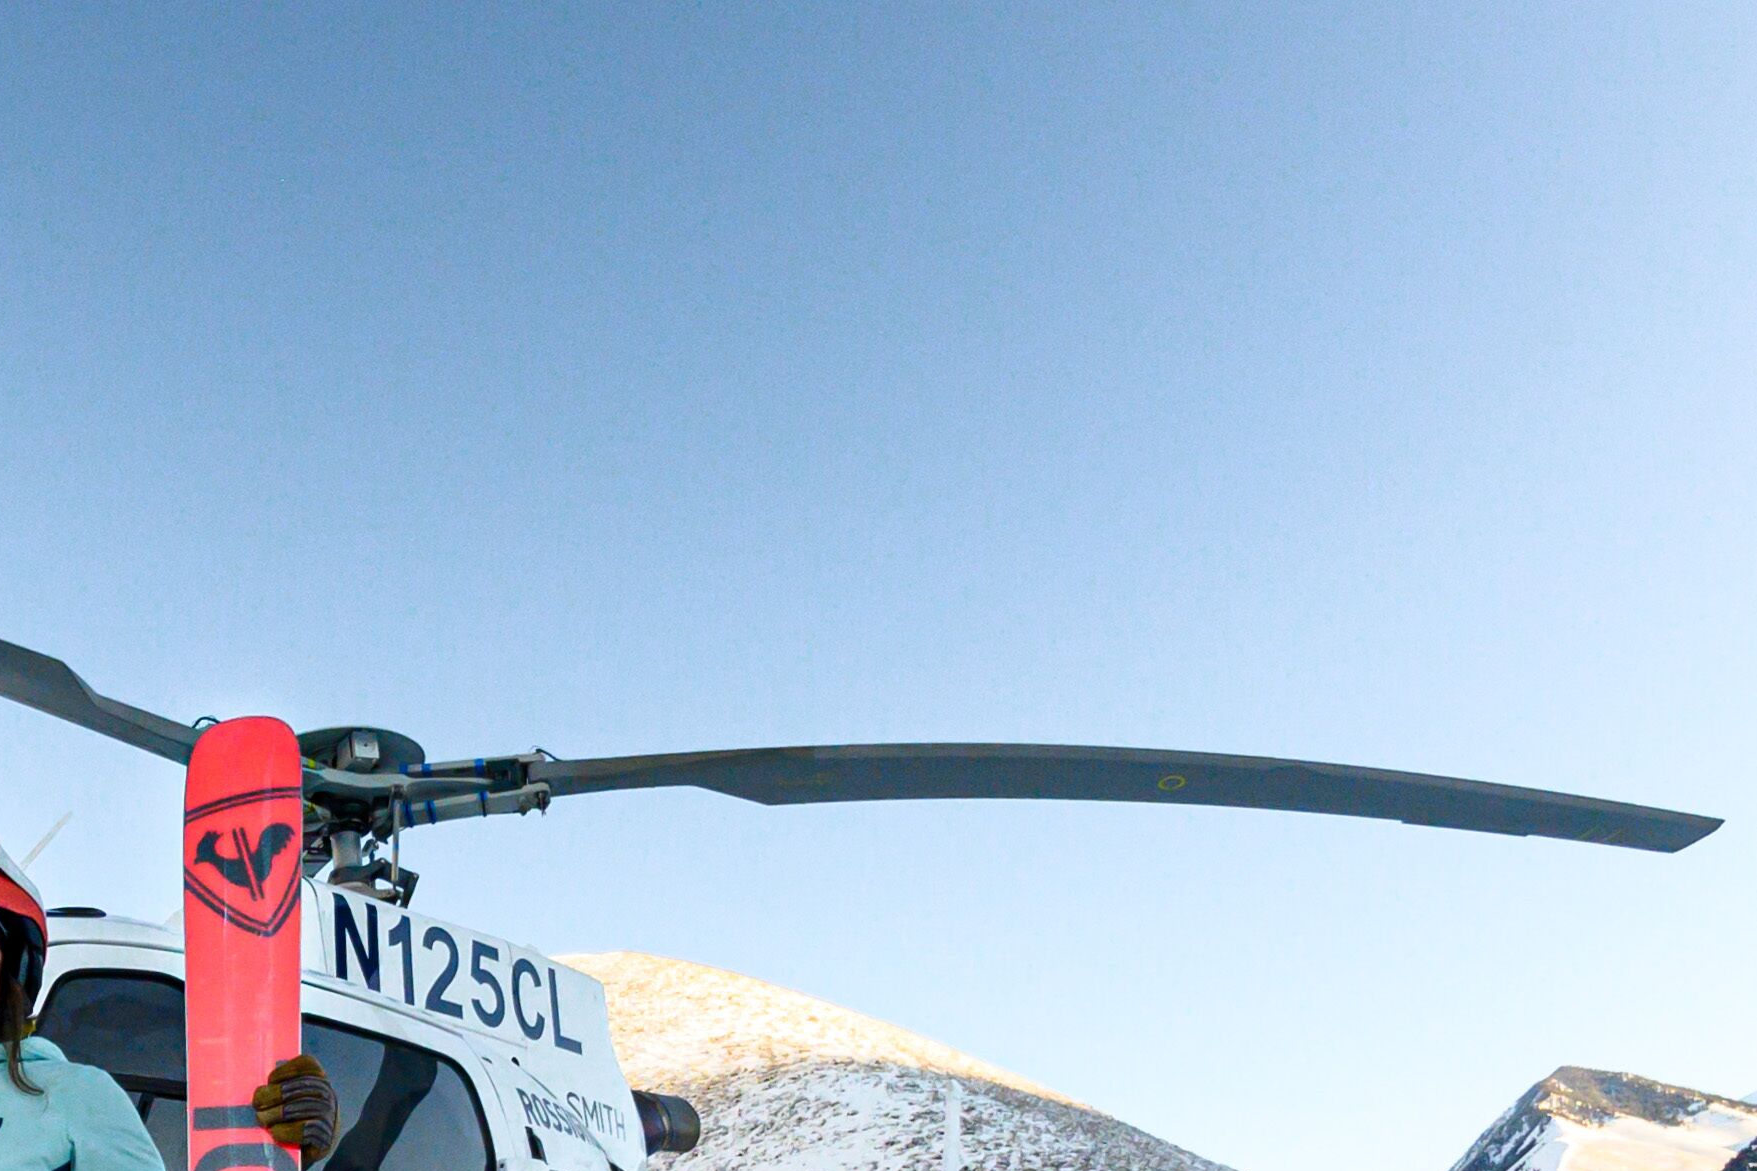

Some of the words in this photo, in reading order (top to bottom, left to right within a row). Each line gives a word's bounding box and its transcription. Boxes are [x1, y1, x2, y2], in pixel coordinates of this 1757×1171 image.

[332, 892, 583, 1056] N125CL
[516, 1087, 594, 1146] ROSSI
[566, 1091, 626, 1142] SMITH
